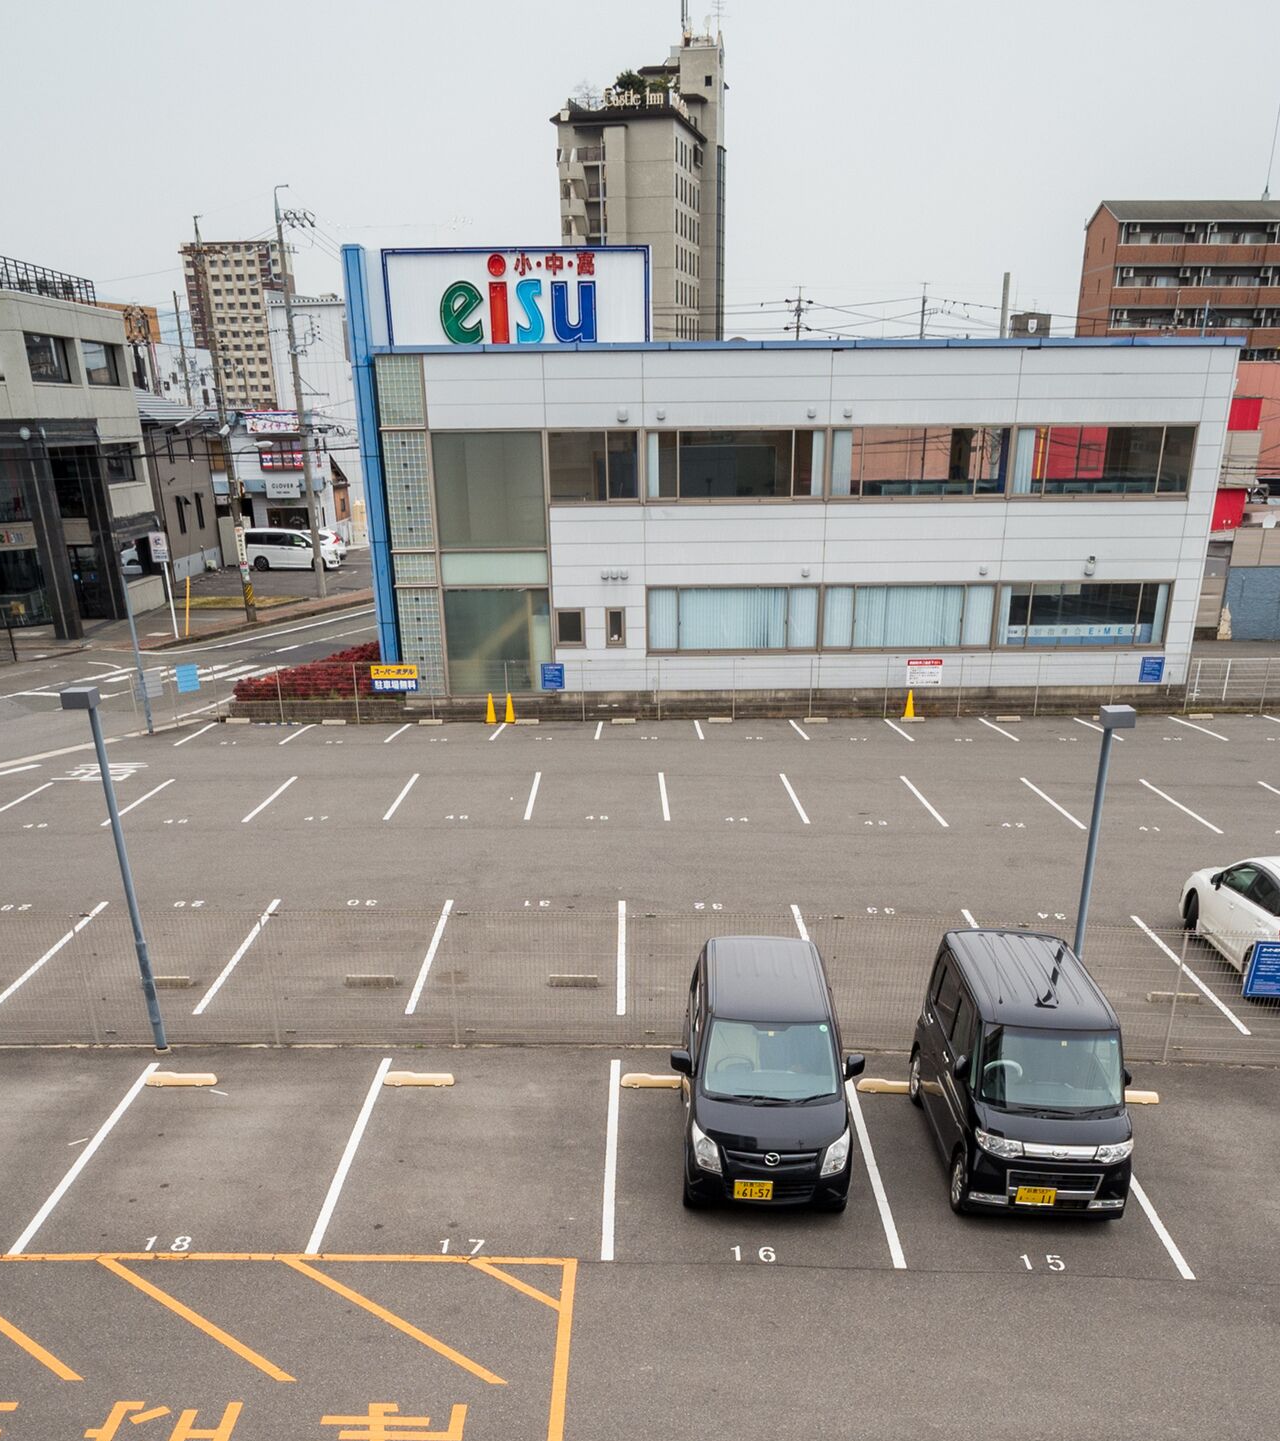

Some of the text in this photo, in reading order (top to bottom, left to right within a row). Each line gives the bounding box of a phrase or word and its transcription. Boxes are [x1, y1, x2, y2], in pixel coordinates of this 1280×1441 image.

[643, 86, 664, 105] Inn
[440, 253, 597, 344] eisu
[144, 1235, 193, 1251] 18
[439, 1238, 486, 1255] 17
[729, 1244, 776, 1263] 16
[1019, 1254, 1066, 1272] 15
